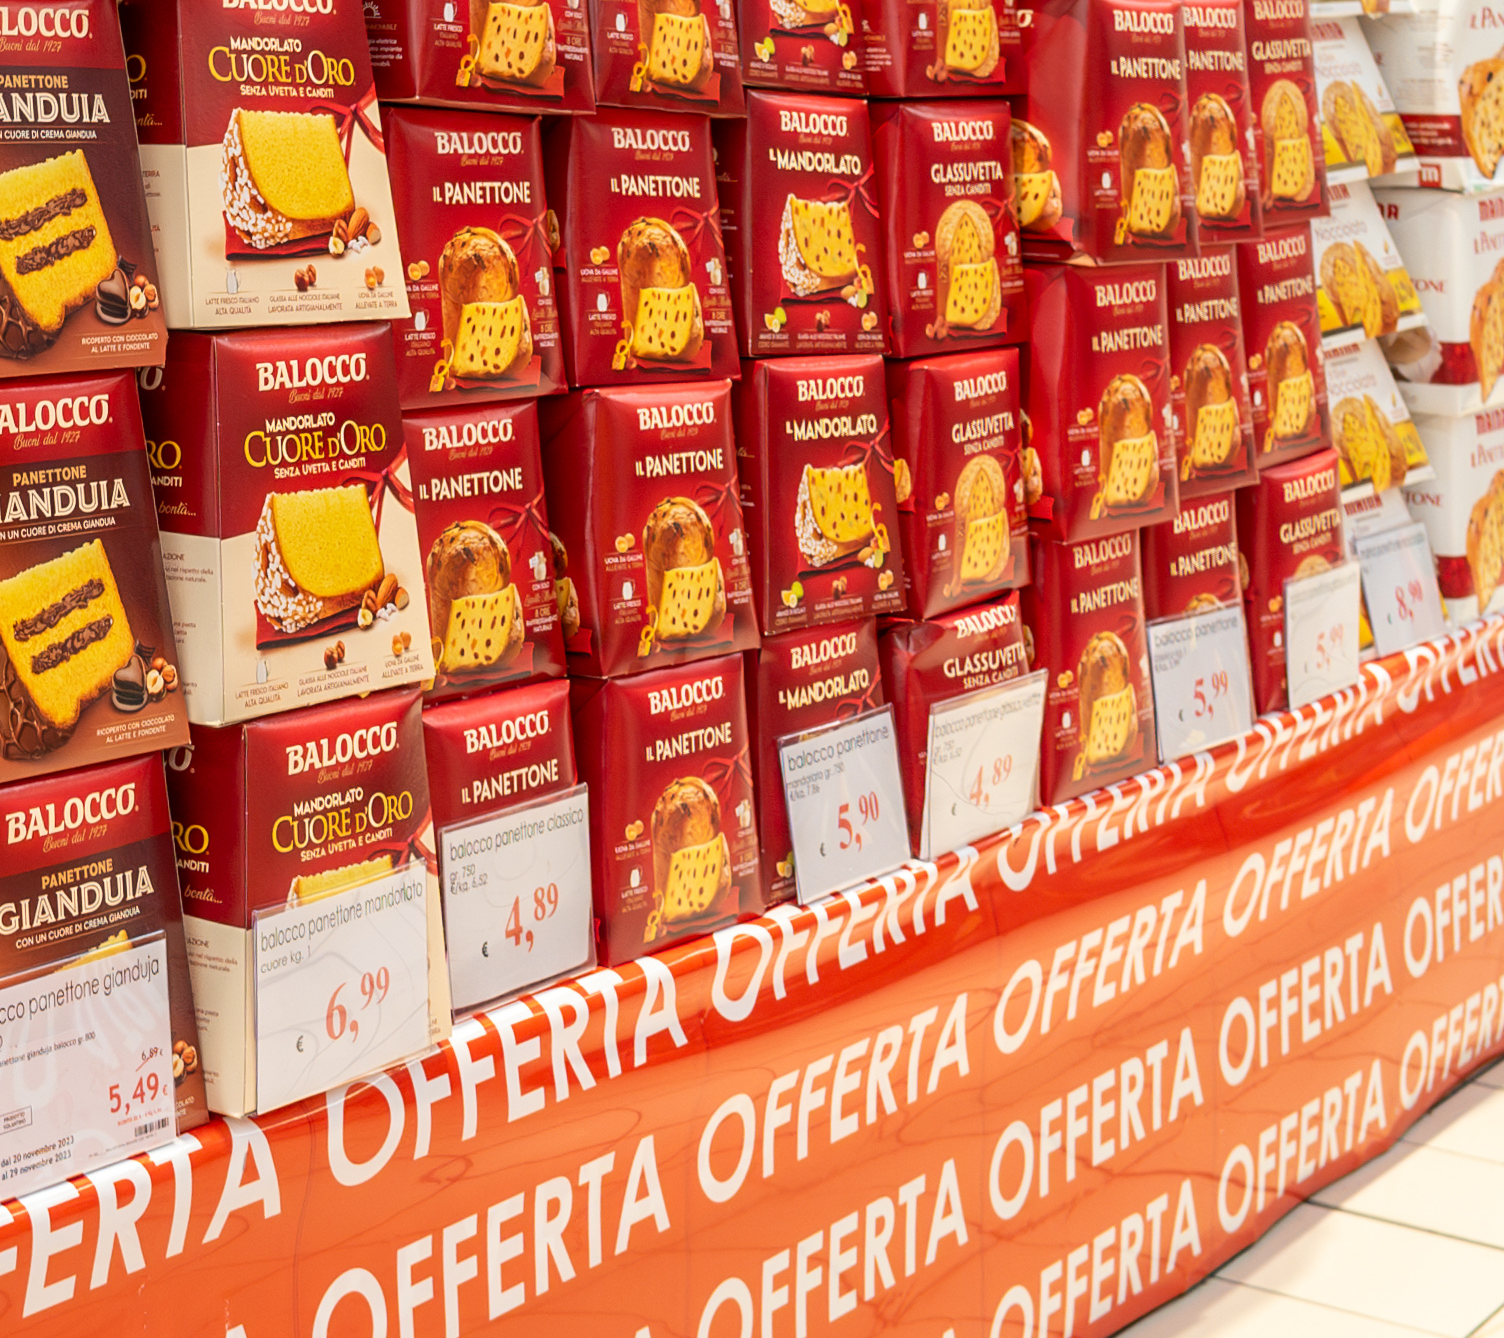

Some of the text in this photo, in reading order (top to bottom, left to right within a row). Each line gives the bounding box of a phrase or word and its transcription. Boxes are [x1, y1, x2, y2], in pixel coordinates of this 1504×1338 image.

[230, 36, 302, 51] MANDORLATO
[209, 45, 293, 82] CUORE
[240, 85, 334, 98] SENZA UVETTA E CANDITI
[422, 419, 515, 453] BALOCCO
[792, 414, 878, 441] MANDORLATO
[951, 409, 1015, 442] GLASSUVETTA
[431, 467, 523, 500] PANETTONE
[1223, 792, 1391, 937] OFFERTA
[260, 881, 423, 952] balocco panettone mandorlato
[29, 979, 99, 1020] panettone
[103, 955, 159, 996] gianduja
[992, 885, 1205, 1055] OFFERTA
[698, 991, 972, 1202] OFFERTA
